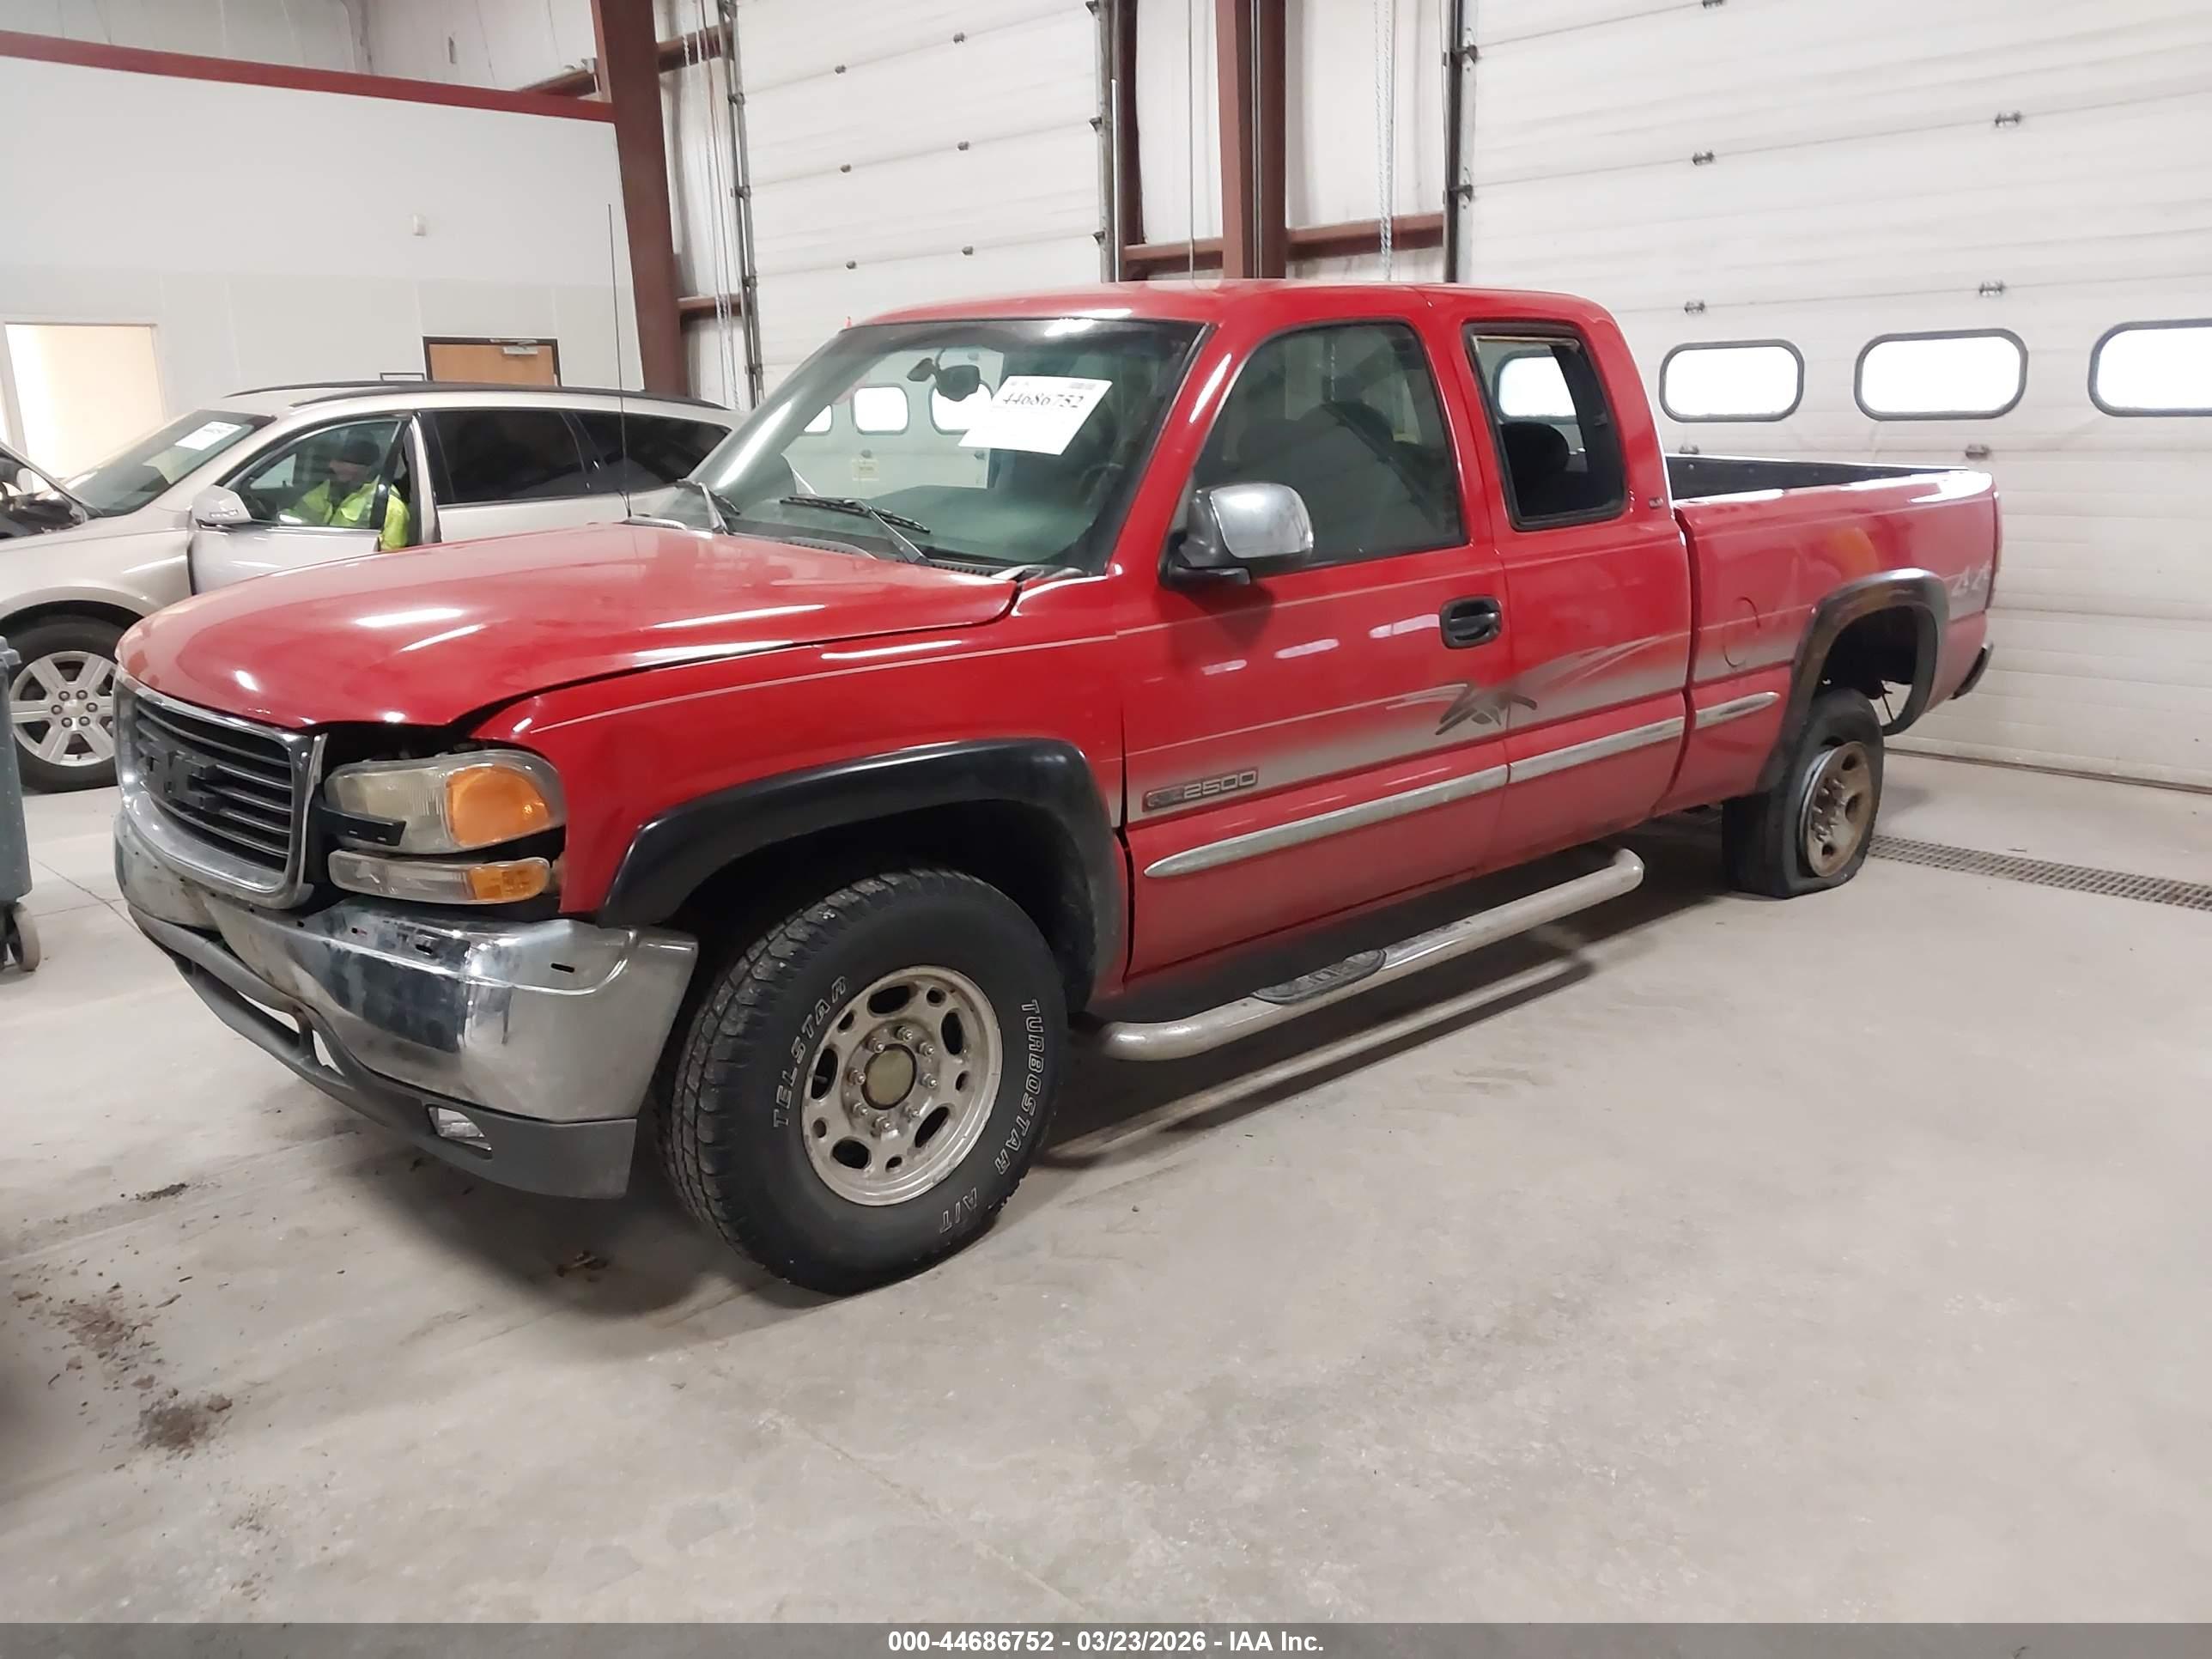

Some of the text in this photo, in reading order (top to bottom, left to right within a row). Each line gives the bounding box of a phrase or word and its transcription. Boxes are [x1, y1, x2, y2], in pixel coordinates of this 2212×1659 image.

[1183, 769, 1257, 799] 2500
[773, 975, 848, 1128] TELSTAR
[994, 999, 1045, 1176] TURBOSTAR
